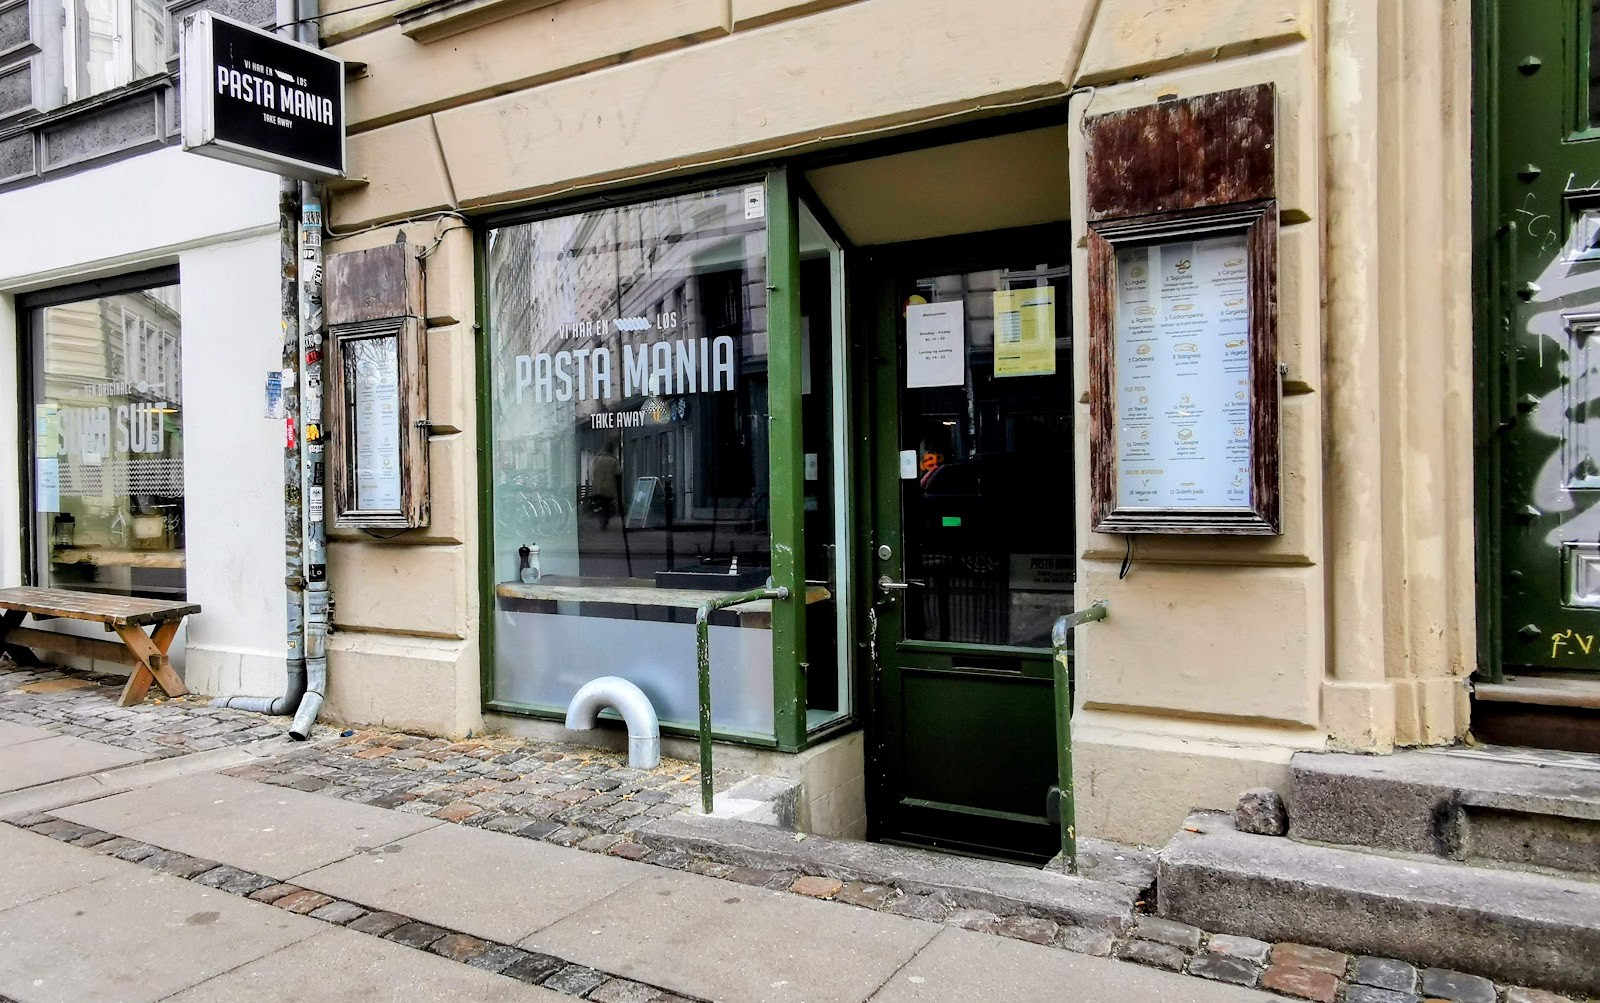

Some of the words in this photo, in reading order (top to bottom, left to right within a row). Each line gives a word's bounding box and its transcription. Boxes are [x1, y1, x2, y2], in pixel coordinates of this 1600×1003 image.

[244, 59, 250, 69] VI
[252, 62, 264, 74] HAR
[265, 66, 273, 77] EN
[217, 65, 275, 109] PASTA
[280, 85, 333, 126] MANIA
[263, 113, 276, 125] TAKE
[277, 117, 293, 129] AWAY
[559, 323, 569, 339] VI
[572, 321, 592, 338] HAR
[596, 319, 609, 336] EN
[657, 312, 677, 330] LØS
[515, 347, 611, 405] PASTA
[623, 335, 734, 398] MANIA
[116, 401, 168, 453] SULT
[590, 412, 614, 429] TAKE
[617, 411, 646, 428] AWAY
